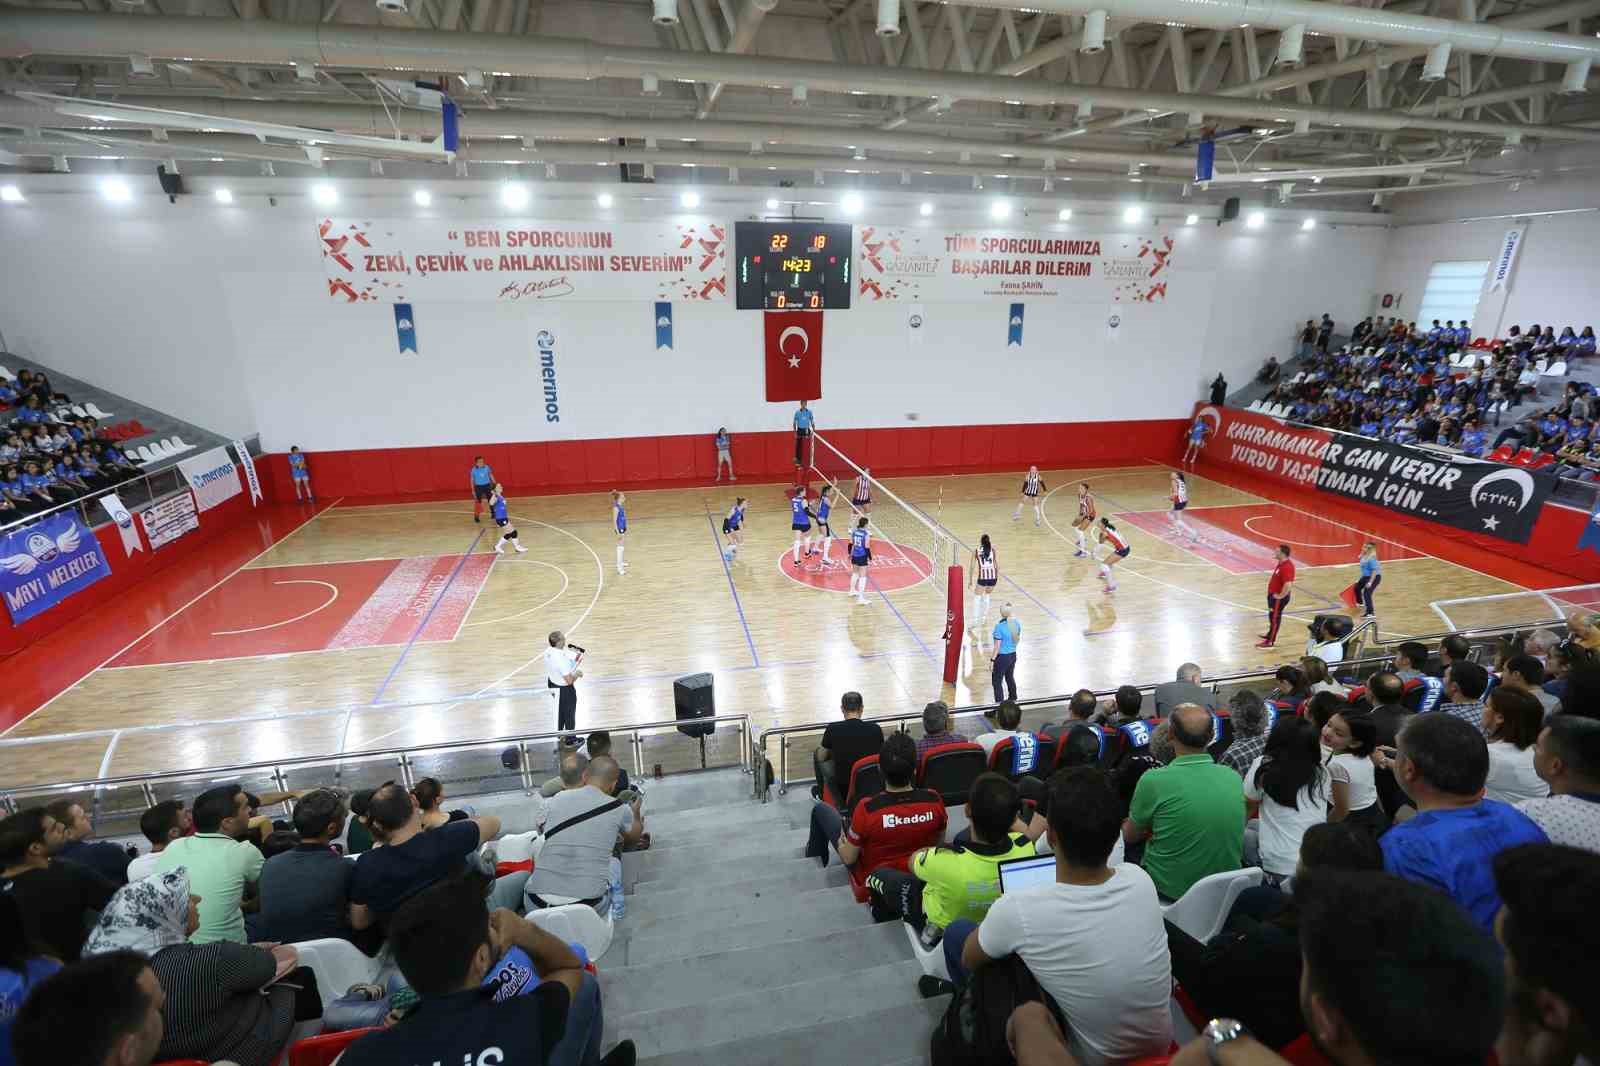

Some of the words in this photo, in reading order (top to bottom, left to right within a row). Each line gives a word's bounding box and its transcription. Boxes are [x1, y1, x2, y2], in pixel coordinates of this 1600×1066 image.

[464, 231, 501, 247] BEN
[506, 231, 612, 248] SPORCUNUN
[771, 235, 788, 248] 22
[814, 235, 826, 248] 18
[944, 232, 977, 253] TÜM
[981, 237, 1101, 256] SPORCULARIMIZA
[415, 251, 469, 276] ÇEVİK
[473, 256, 493, 271] ve
[499, 254, 604, 271] AHLAKLISINI
[782, 259, 811, 272] 14:23
[952, 259, 1031, 279] BAŞARILAR
[777, 295, 786, 308] 0
[810, 295, 819, 308] 0
[540, 350, 560, 423] merinos
[1226, 421, 1343, 464] KAHRAMANLAR
[1344, 447, 1389, 471] CAN
[1388, 455, 1463, 491] VERİR
[1230, 444, 1279, 471] YURDU
[1280, 458, 1373, 499] YAŞATMAK
[894, 811, 934, 825] kadoil
